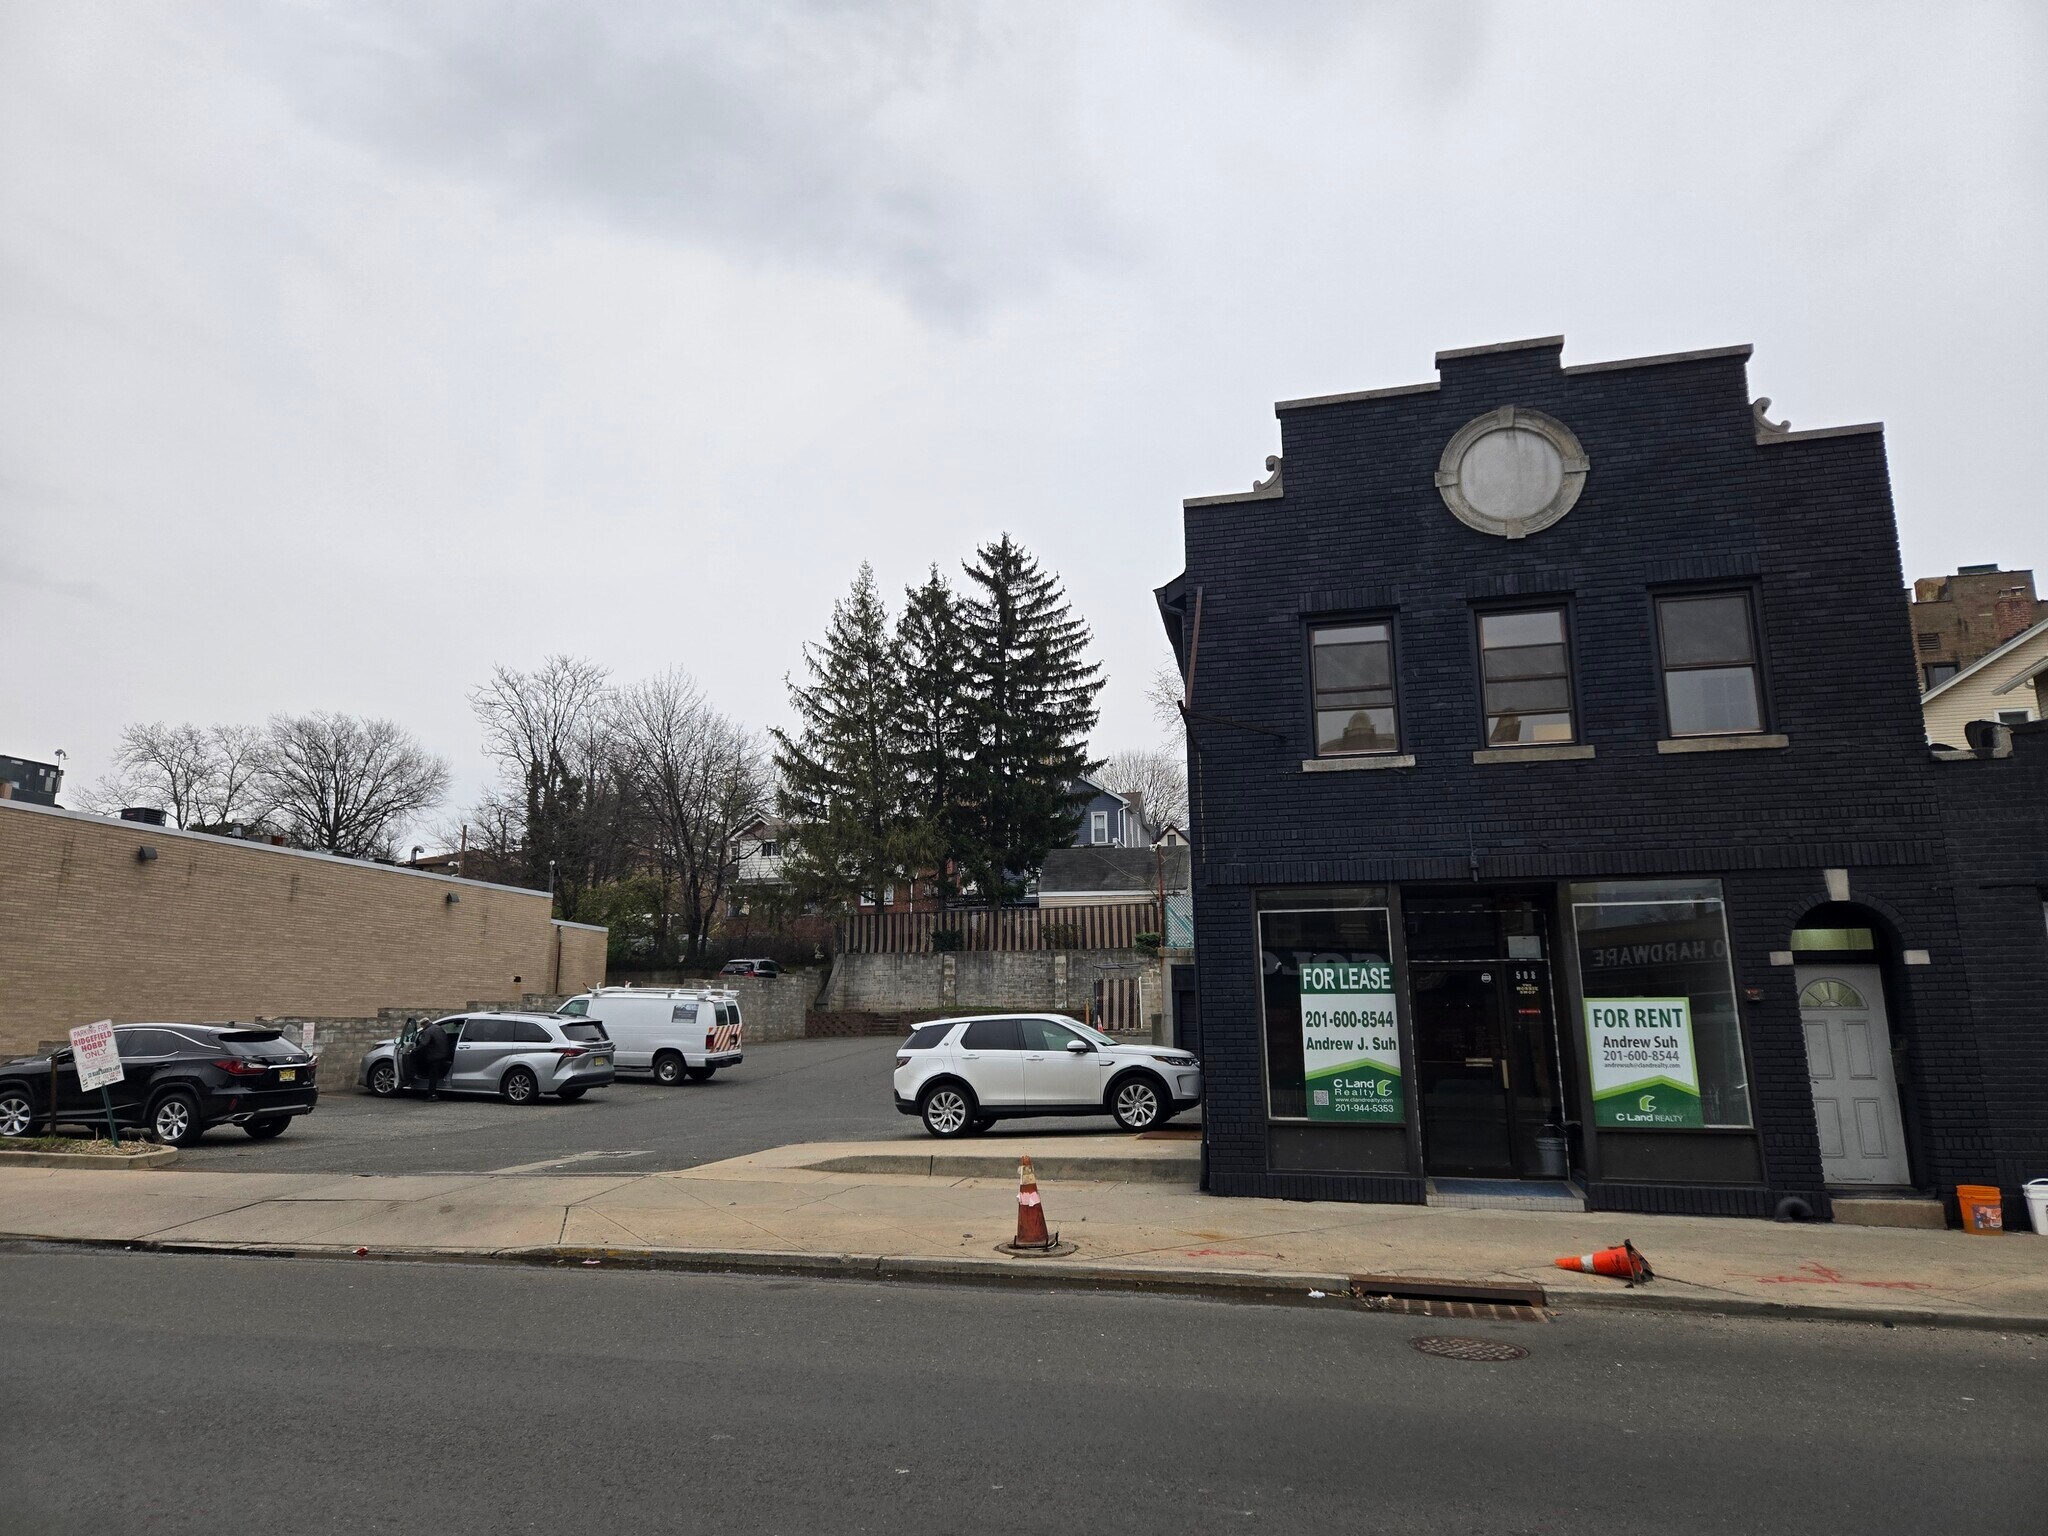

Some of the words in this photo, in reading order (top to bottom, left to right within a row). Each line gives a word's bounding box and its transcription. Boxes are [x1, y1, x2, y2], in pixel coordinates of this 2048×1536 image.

[1303, 967, 1336, 990] FOR
[1339, 967, 1391, 990] LEASE
[1305, 1010, 1394, 1028] 201-600-8544
[1593, 1008, 1630, 1028] FOR
[1634, 1008, 1683, 1028] RENT
[73, 1027, 97, 1038] PARKING
[97, 1023, 109, 1032] FOR
[73, 1030, 112, 1047] RIDGEFIELD
[1306, 1037, 1353, 1050] Andrew
[1357, 1037, 1369, 1050] J.
[1372, 1037, 1397, 1051] Suh
[1603, 1036, 1651, 1048] Andrew
[1653, 1036, 1678, 1048] Suh
[81, 1039, 107, 1053] HOBBY
[84, 1048, 107, 1059] ONLY
[1603, 1050, 1679, 1061] 201-600-8544
[1333, 1079, 1343, 1088] C
[1345, 1079, 1375, 1088] Land
[1334, 1088, 1375, 1098] Realty
[1335, 1104, 1394, 1112] 201-944-5353
[1616, 1113, 1625, 1121] C
[1626, 1113, 1653, 1122] Land
[1655, 1114, 1684, 1122] REALTY
